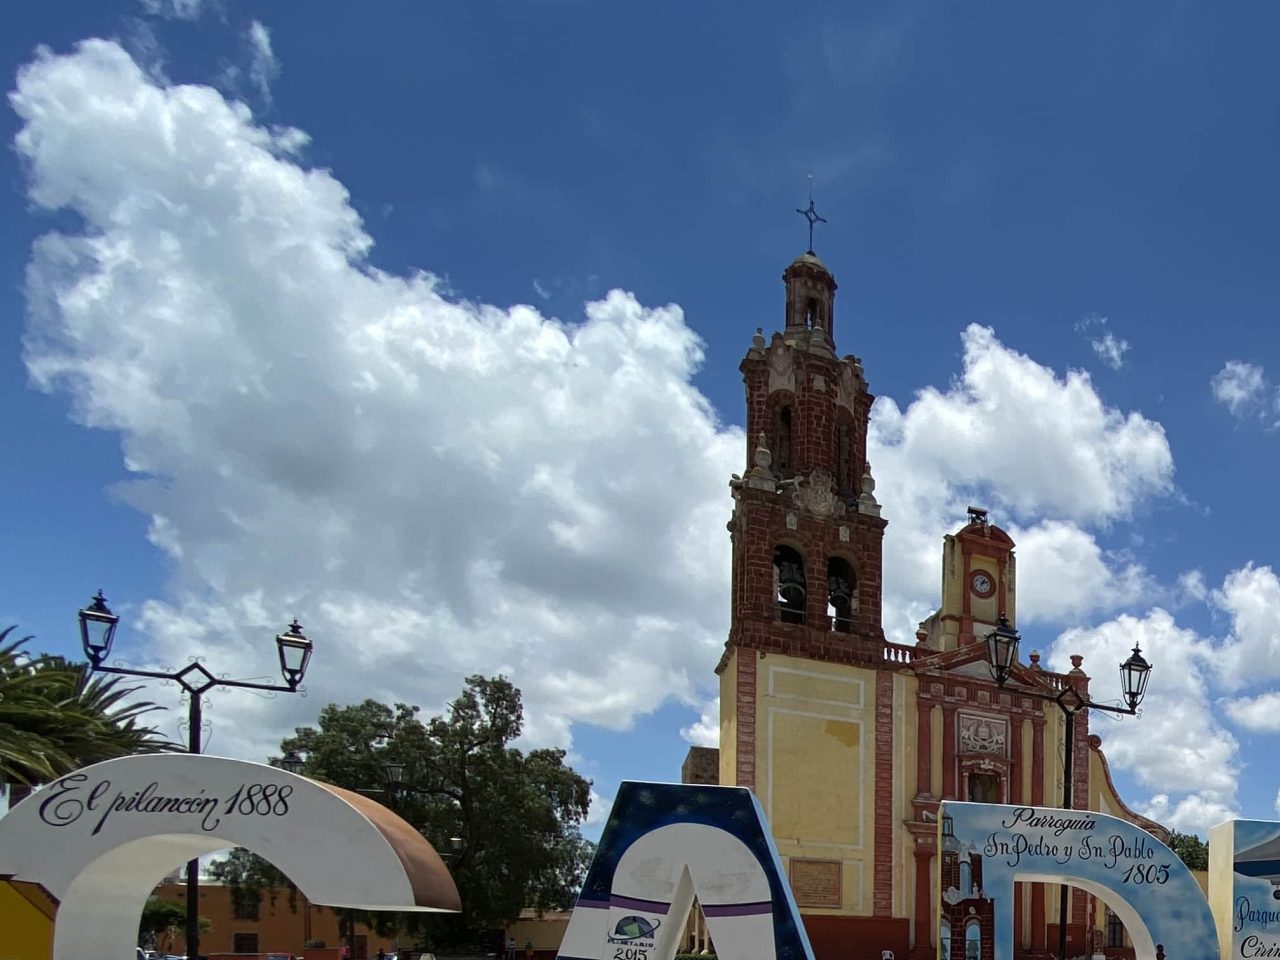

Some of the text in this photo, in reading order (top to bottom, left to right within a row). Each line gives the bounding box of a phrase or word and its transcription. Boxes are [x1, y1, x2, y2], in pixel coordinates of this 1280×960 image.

[39, 774, 110, 827] El
[225, 783, 294, 816] 1888
[1006, 833, 1058, 868] Pedro
[1055, 844, 1073, 865] y
[1104, 834, 1154, 869] Pablo
[1122, 863, 1172, 885] 1805
